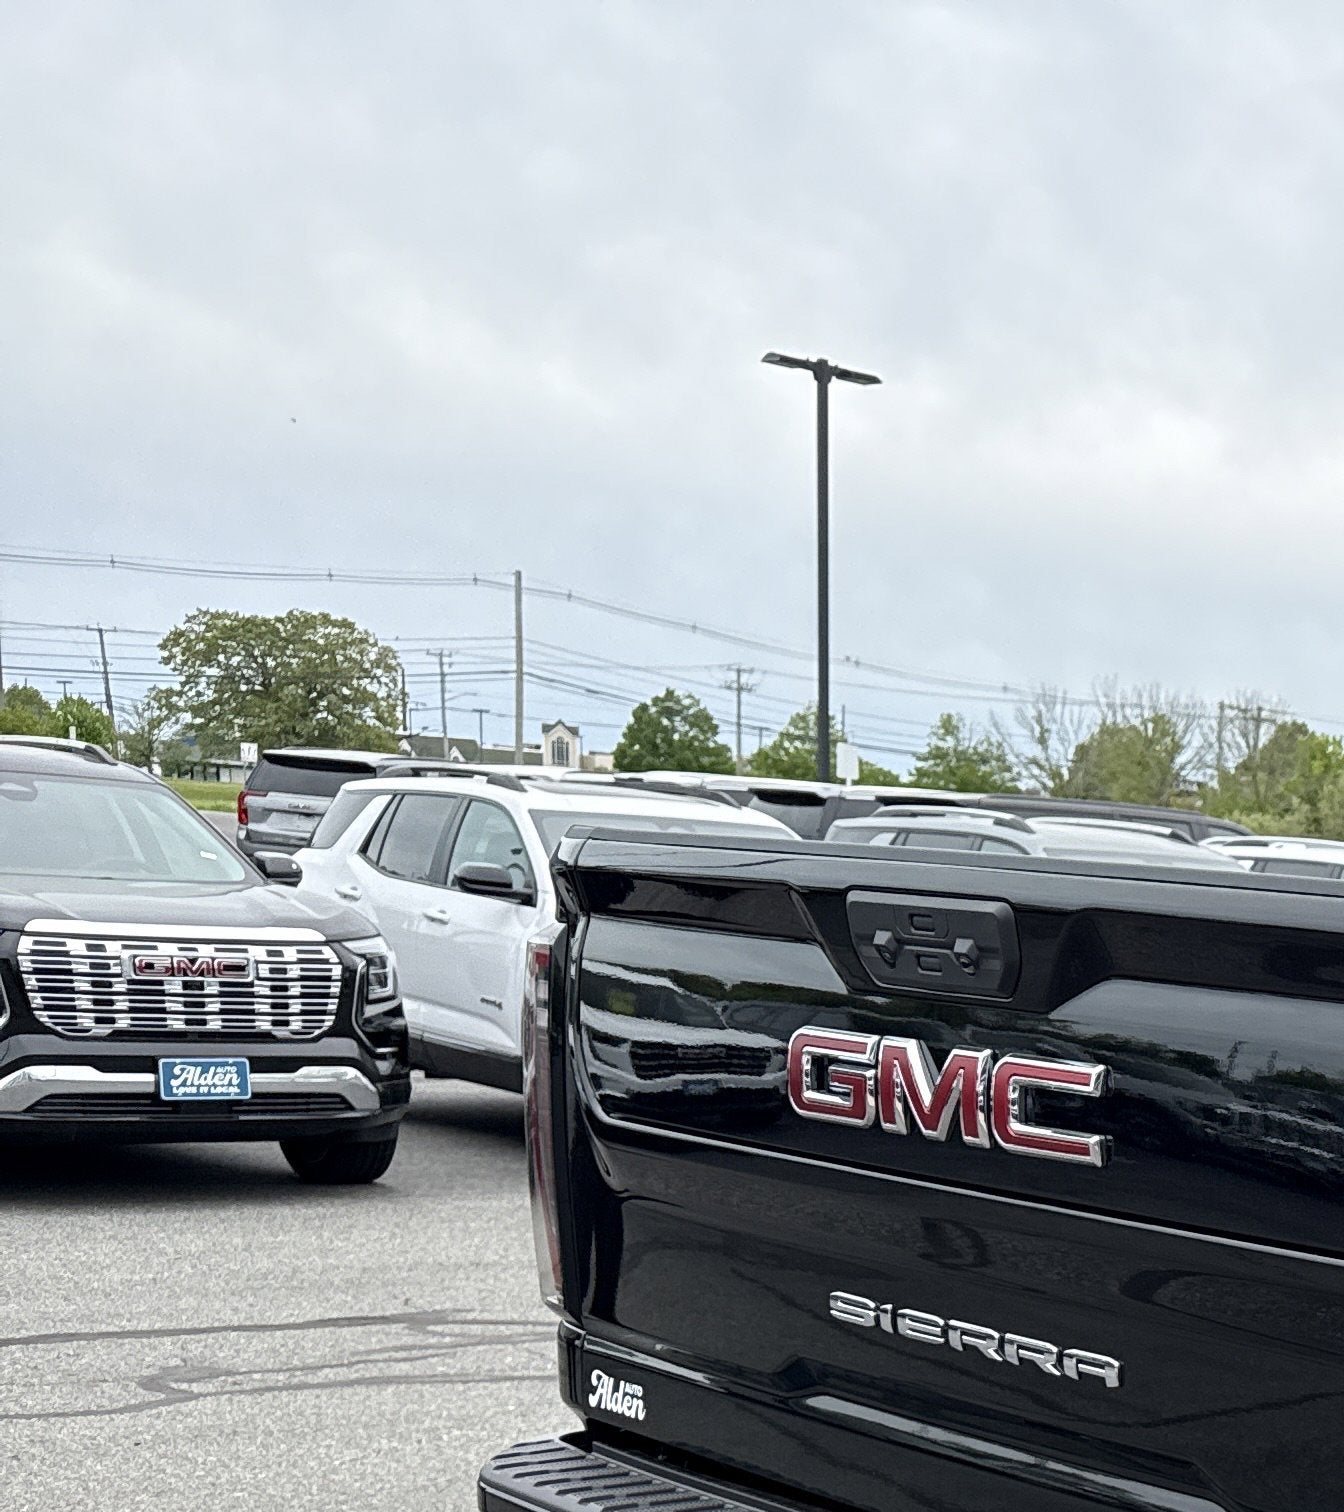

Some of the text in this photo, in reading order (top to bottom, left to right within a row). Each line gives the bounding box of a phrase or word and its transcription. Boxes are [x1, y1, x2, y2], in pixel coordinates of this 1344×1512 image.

[134, 955, 250, 979] GMC
[170, 1064, 241, 1087] Alden
[216, 1065, 238, 1074] AUTO
[787, 1026, 1112, 1168] GMC
[829, 1290, 1125, 1388] SIERRA
[588, 1369, 647, 1421] Alden
[624, 1381, 643, 1397] AUTO
